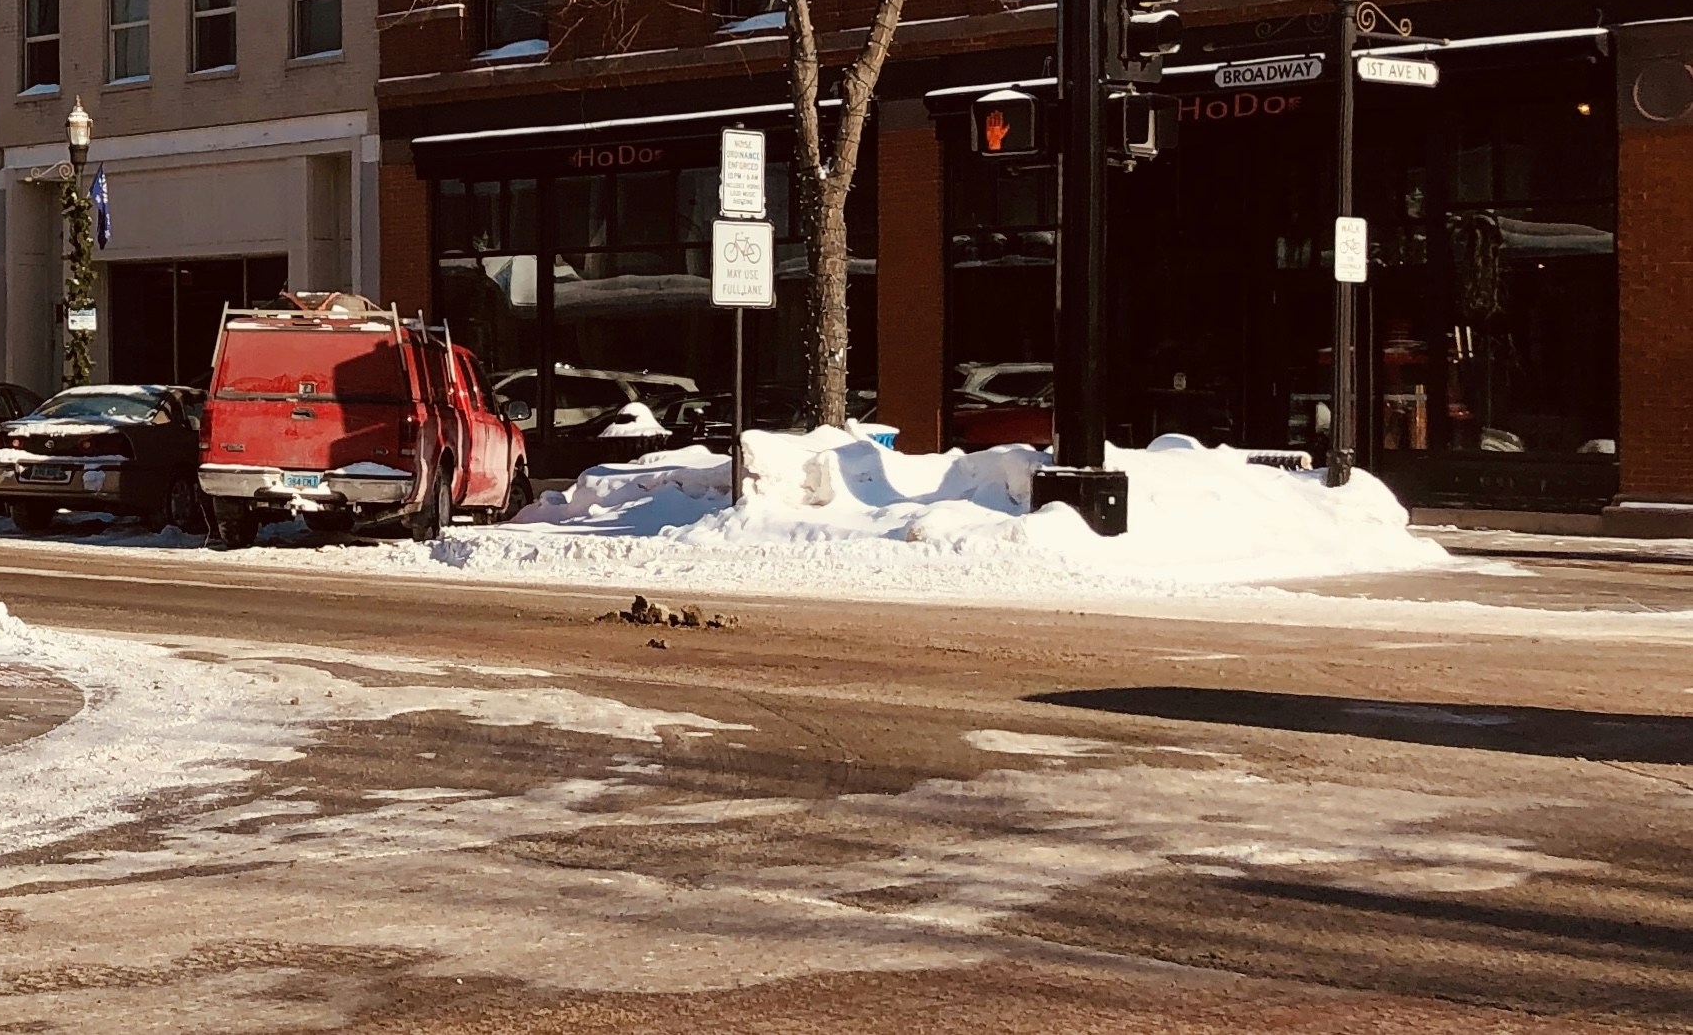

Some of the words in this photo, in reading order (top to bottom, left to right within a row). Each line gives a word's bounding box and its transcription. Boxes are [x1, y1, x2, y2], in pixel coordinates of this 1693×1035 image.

[1223, 61, 1315, 85] BROADWAY
[1366, 62, 1384, 76] 1ST
[1388, 64, 1412, 79] AVE
[1417, 66, 1427, 81] N
[1177, 92, 1286, 121] HoDo
[577, 145, 653, 168] HoDo
[726, 150, 760, 160] ORDINANCE
[726, 269, 742, 279] MAY
[744, 270, 759, 280] USE
[723, 284, 740, 295] FULL
[743, 285, 763, 295] LANE
